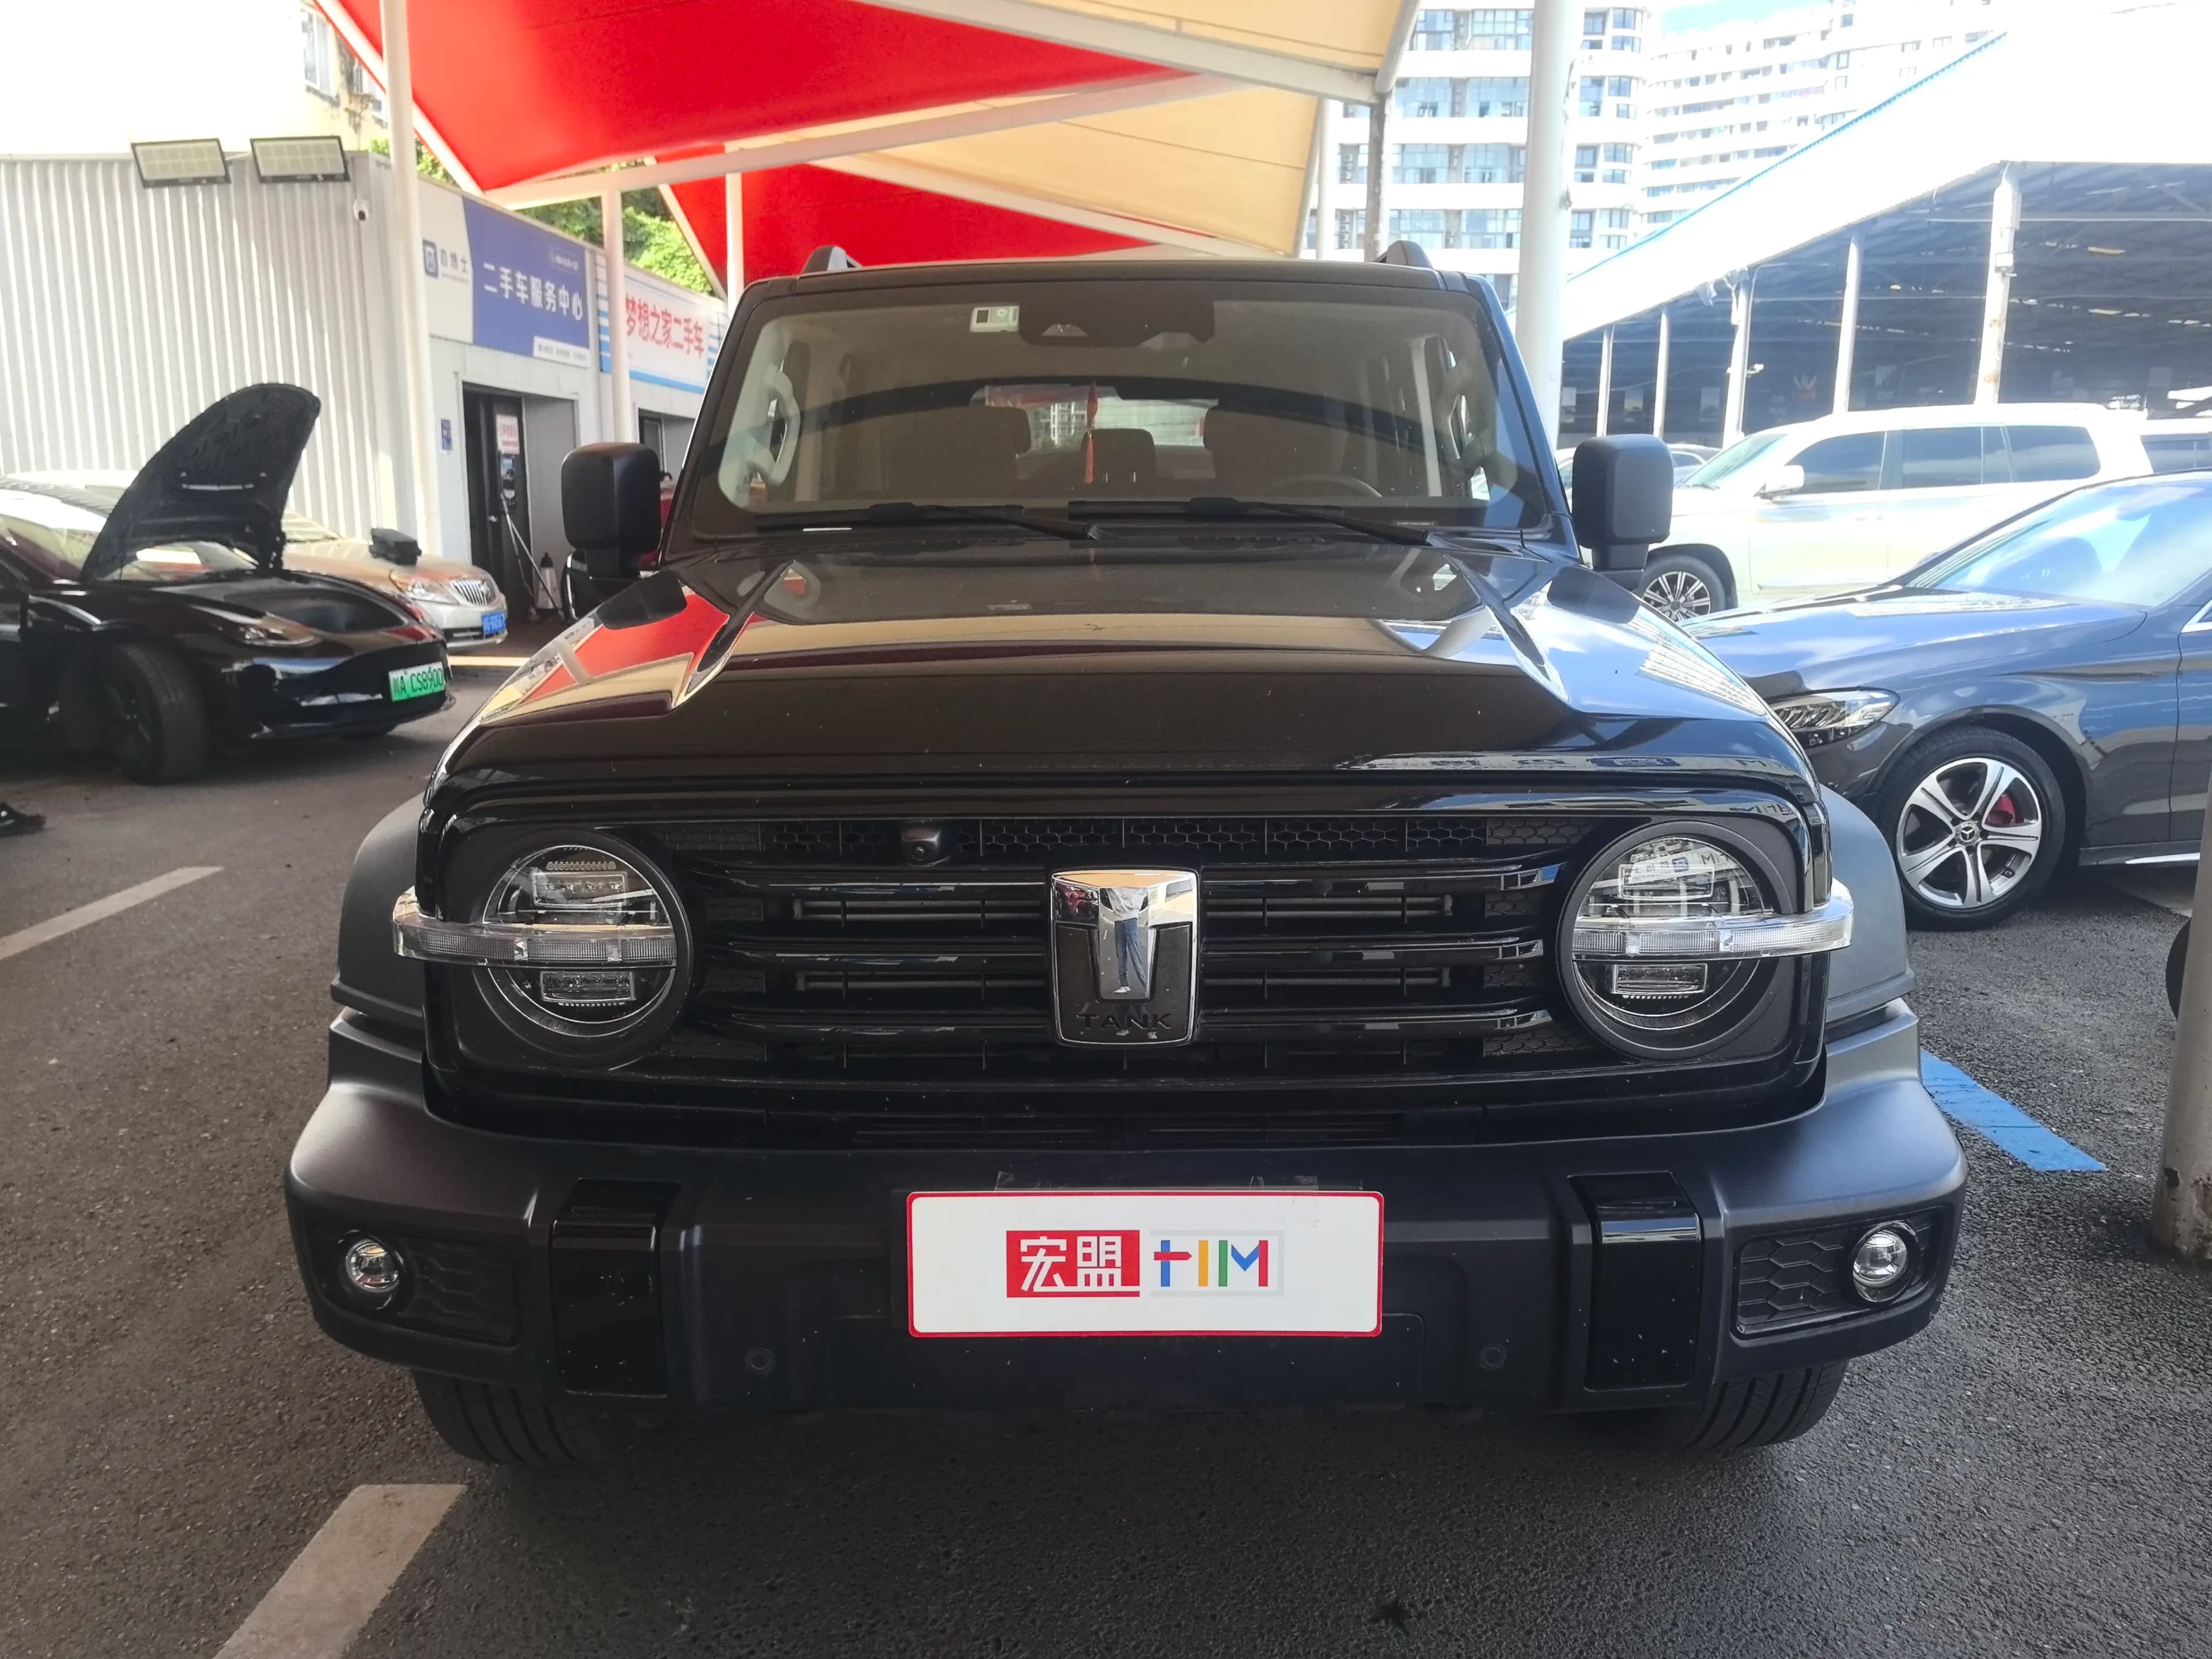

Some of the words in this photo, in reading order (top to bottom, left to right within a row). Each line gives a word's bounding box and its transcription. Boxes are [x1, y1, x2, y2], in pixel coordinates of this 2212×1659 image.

[483, 262, 584, 321] 二手车服务中心
[626, 294, 704, 359] 梦想之家二手车
[1076, 1013, 1172, 1029] TANK
[1019, 1235, 1140, 1293] 宏盟
